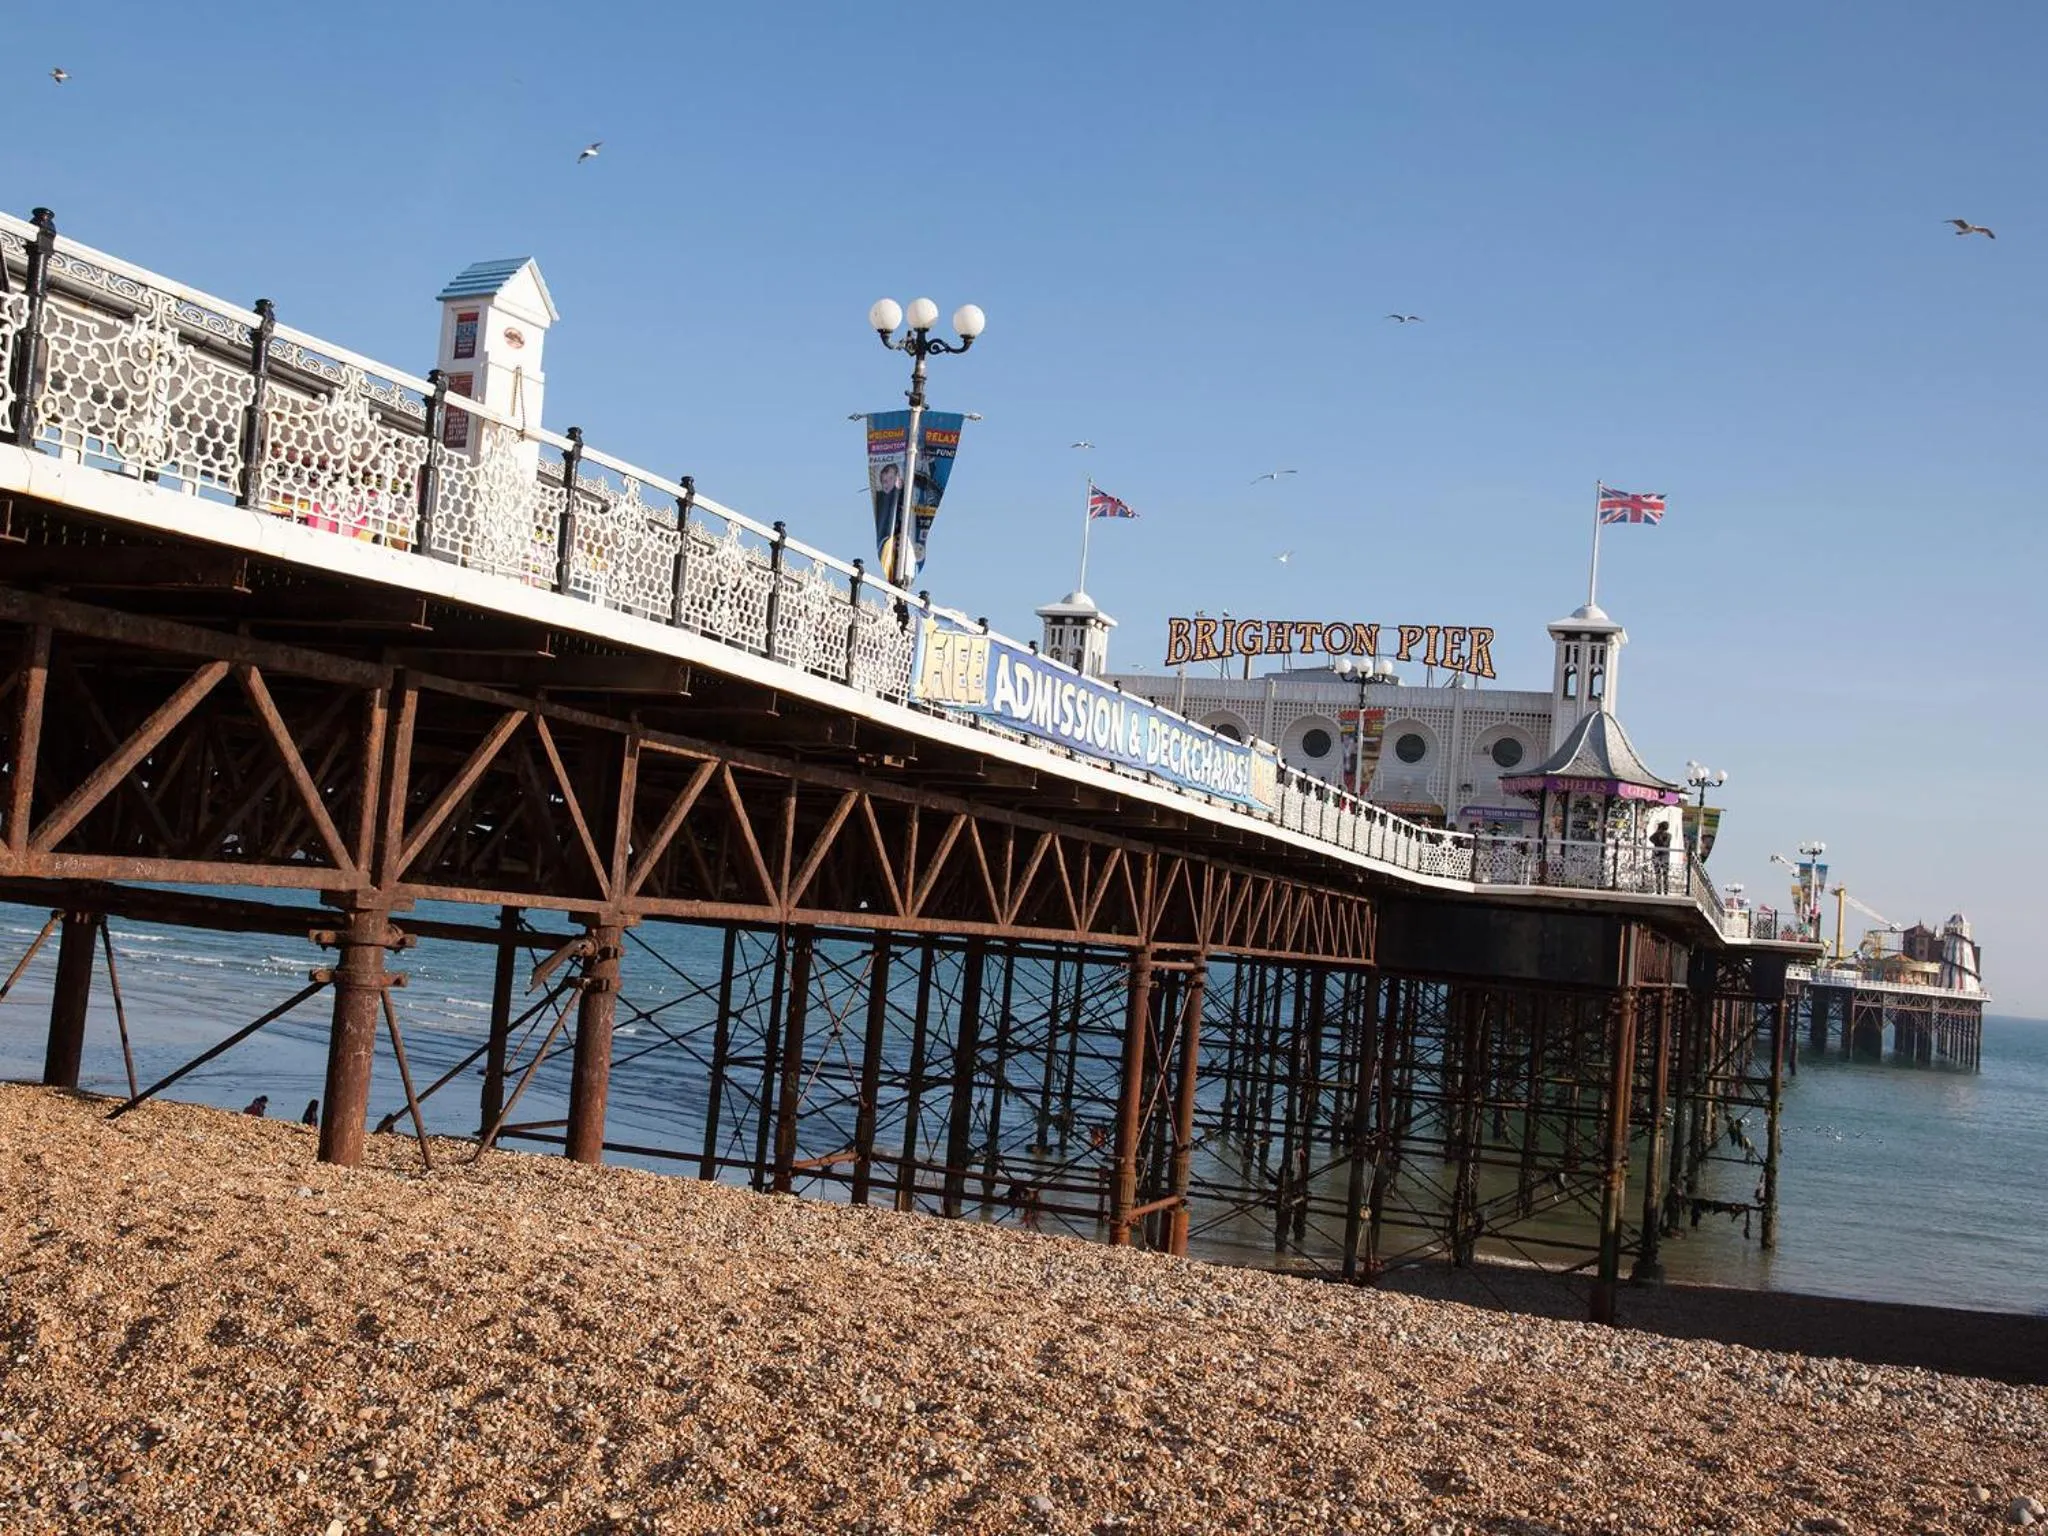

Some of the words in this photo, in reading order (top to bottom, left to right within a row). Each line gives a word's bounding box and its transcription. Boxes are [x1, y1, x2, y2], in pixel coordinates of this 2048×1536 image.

[926, 431, 957, 444] RELAX
[1165, 618, 1379, 666] BRIGHTON
[1397, 625, 1496, 679] PIER
[993, 654, 1125, 754] ADMISSION
[1129, 712, 1140, 758] &
[1147, 716, 1250, 797] DECKCHAIRS!
[1556, 779, 1607, 792] SHELLS
